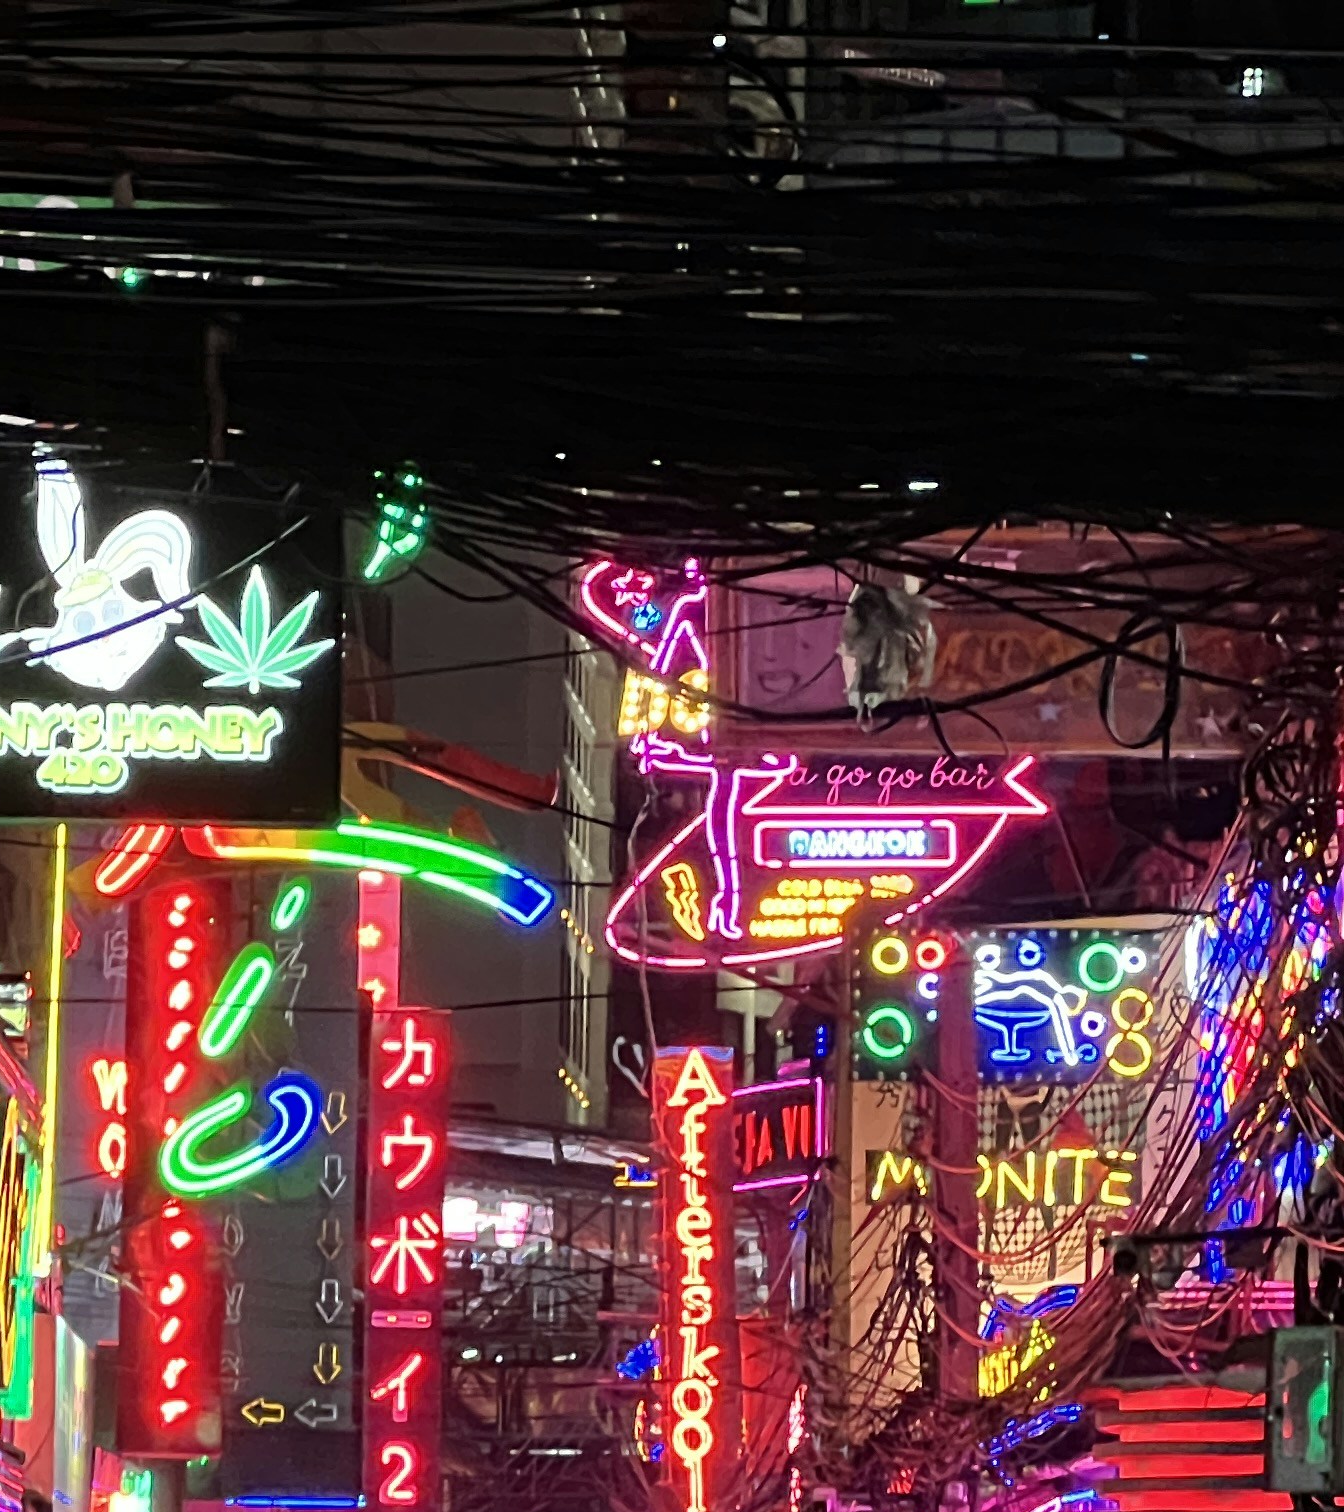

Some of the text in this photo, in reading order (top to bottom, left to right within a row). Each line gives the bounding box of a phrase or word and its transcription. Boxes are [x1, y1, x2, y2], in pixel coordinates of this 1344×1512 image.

[107, 704, 282, 760] HONEY
[39, 748, 126, 790] 420
[789, 755, 996, 807] a go go bar
[731, 1110, 773, 1176] EJA
[870, 1148, 1138, 1208] MNITE
